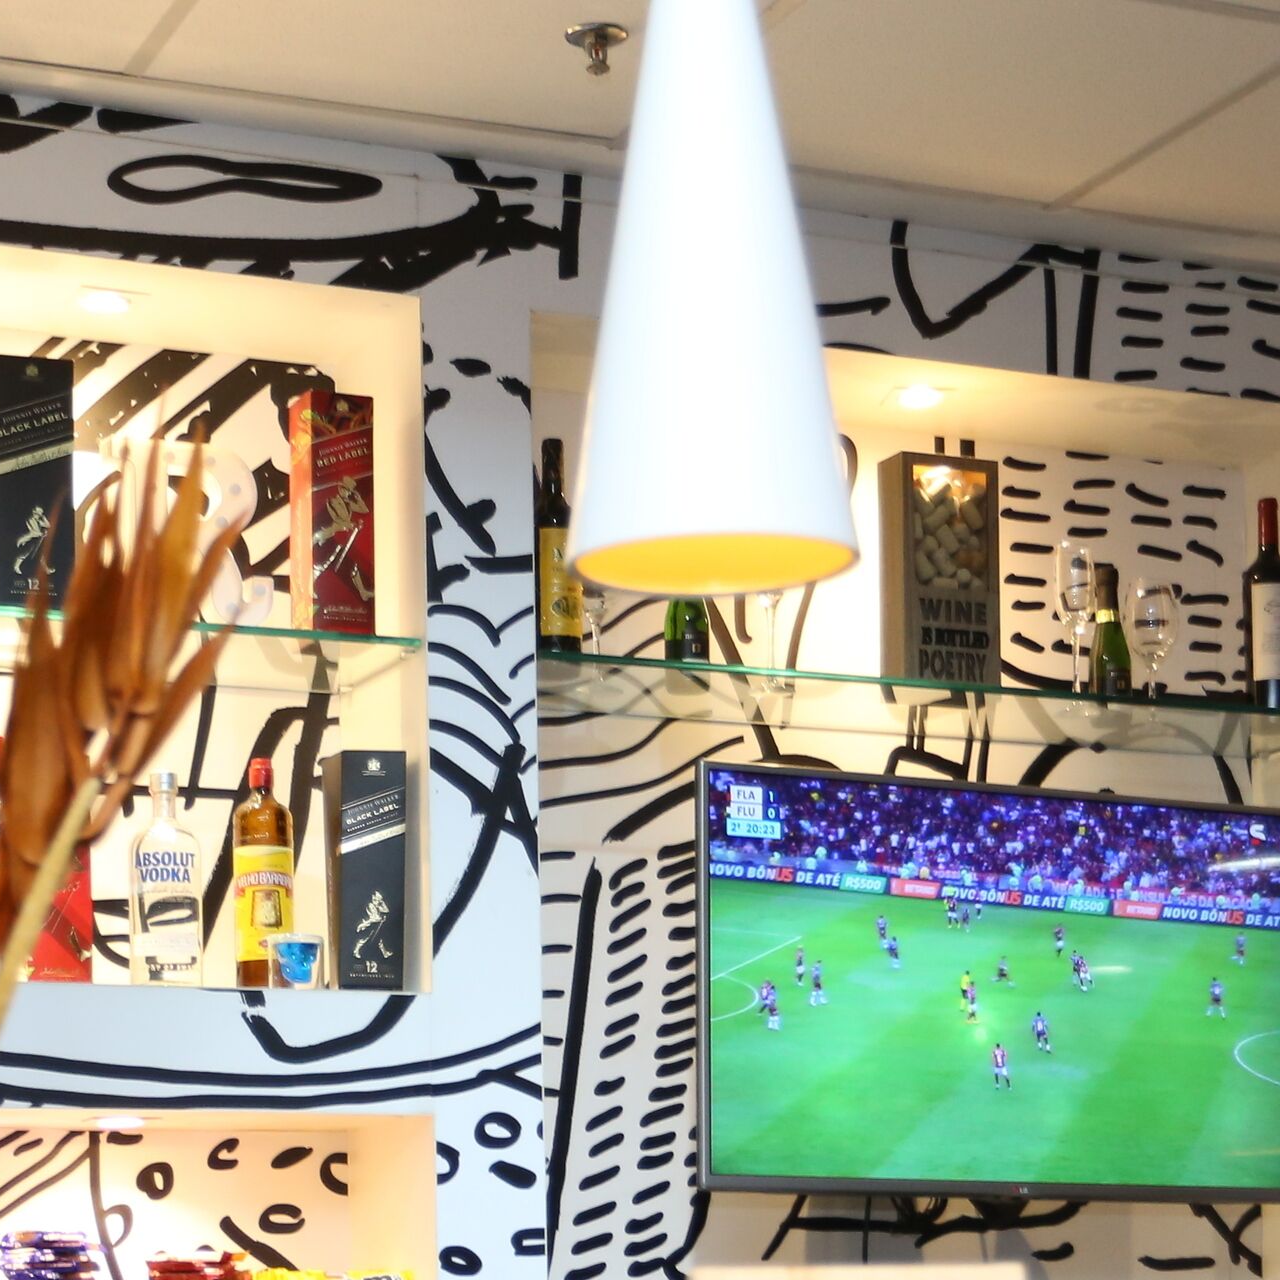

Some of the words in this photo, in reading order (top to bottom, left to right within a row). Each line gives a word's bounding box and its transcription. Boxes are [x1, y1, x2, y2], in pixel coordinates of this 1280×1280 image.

[33, 412, 68, 427] LABEL
[317, 457, 337, 468] RED
[338, 447, 368, 462] LABEL
[27, 578, 40, 590] 12
[919, 598, 987, 626] WINE
[934, 628, 989, 650] BOTTLED
[919, 649, 987, 682] POETRY
[737, 789, 756, 800] FLA
[768, 791, 774, 803] 1
[346, 811, 372, 825] BLACK
[373, 803, 399, 816] LABEL
[737, 806, 756, 817] FLU
[767, 807, 776, 819] 0
[746, 823, 775, 836] 20:23
[135, 852, 195, 868] ABSOLUT
[140, 868, 191, 883] VODKA
[747, 866, 794, 883] BÔNUS
[796, 871, 813, 884] DE
[815, 872, 841, 887] ATÉ
[845, 878, 882, 892] R$500
[1023, 895, 1038, 907] DE
[1041, 895, 1065, 909] ATÉ
[1070, 899, 1104, 912] R$500
[1163, 906, 1197, 921] NOVO
[1200, 908, 1244, 925] BÔNUS
[1246, 914, 1260, 926] DE
[365, 960, 378, 973] 12
